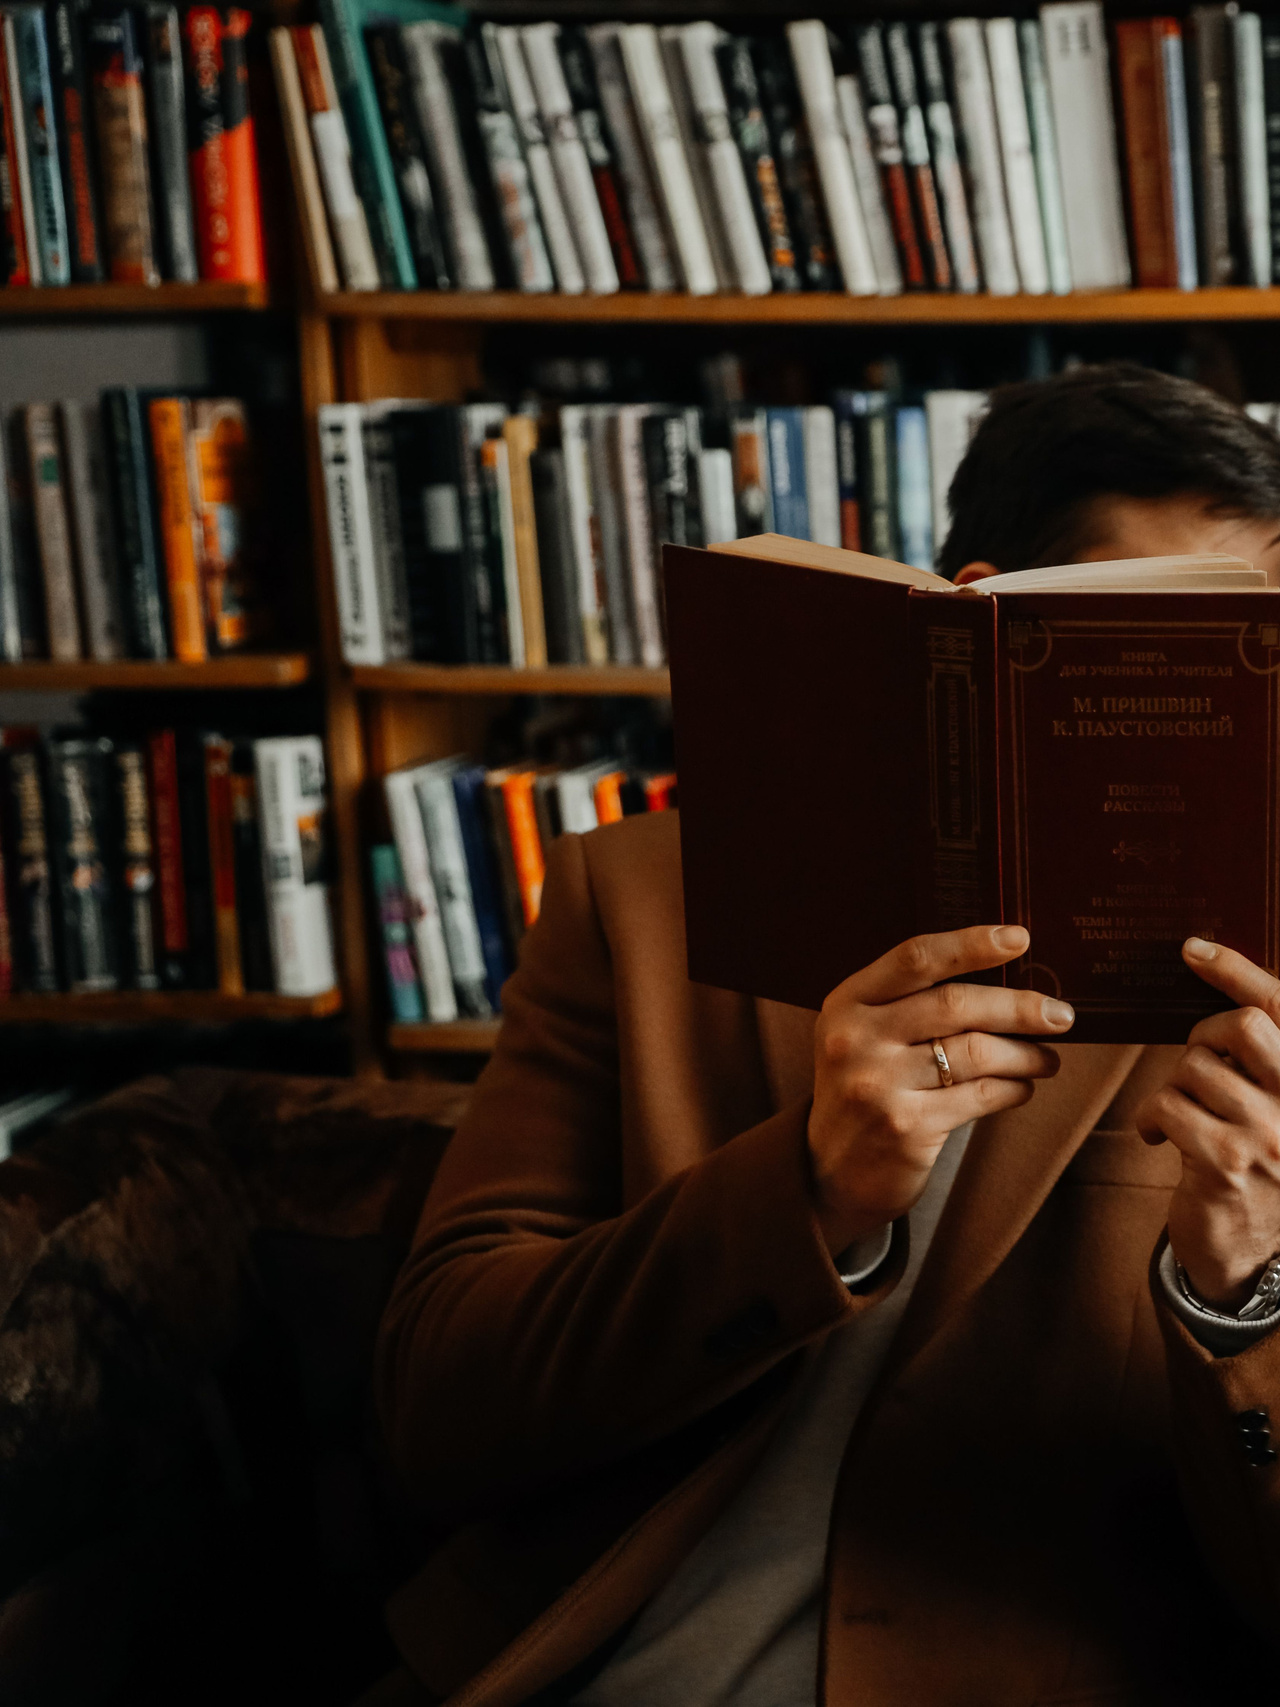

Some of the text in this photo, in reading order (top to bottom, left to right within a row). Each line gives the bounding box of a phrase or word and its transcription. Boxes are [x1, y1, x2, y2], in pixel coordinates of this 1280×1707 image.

[1121, 651, 1168, 663] КНИГА
[1060, 665, 1233, 677] ДЛЯ УЧЕНИКА И УЧИТЕЛЯ
[1073, 697, 1213, 713] М. ПРИШВИН
[1053, 714, 1235, 736] К. ПАУСТОВСКИЙ
[1108, 784, 1180, 796] ПОВЕСТИ
[1103, 800, 1186, 812] РАССКАЗЫ
[1073, 916, 1112, 927] ТЕМЫ
[1081, 930, 1130, 940] ПЛАНЫ
